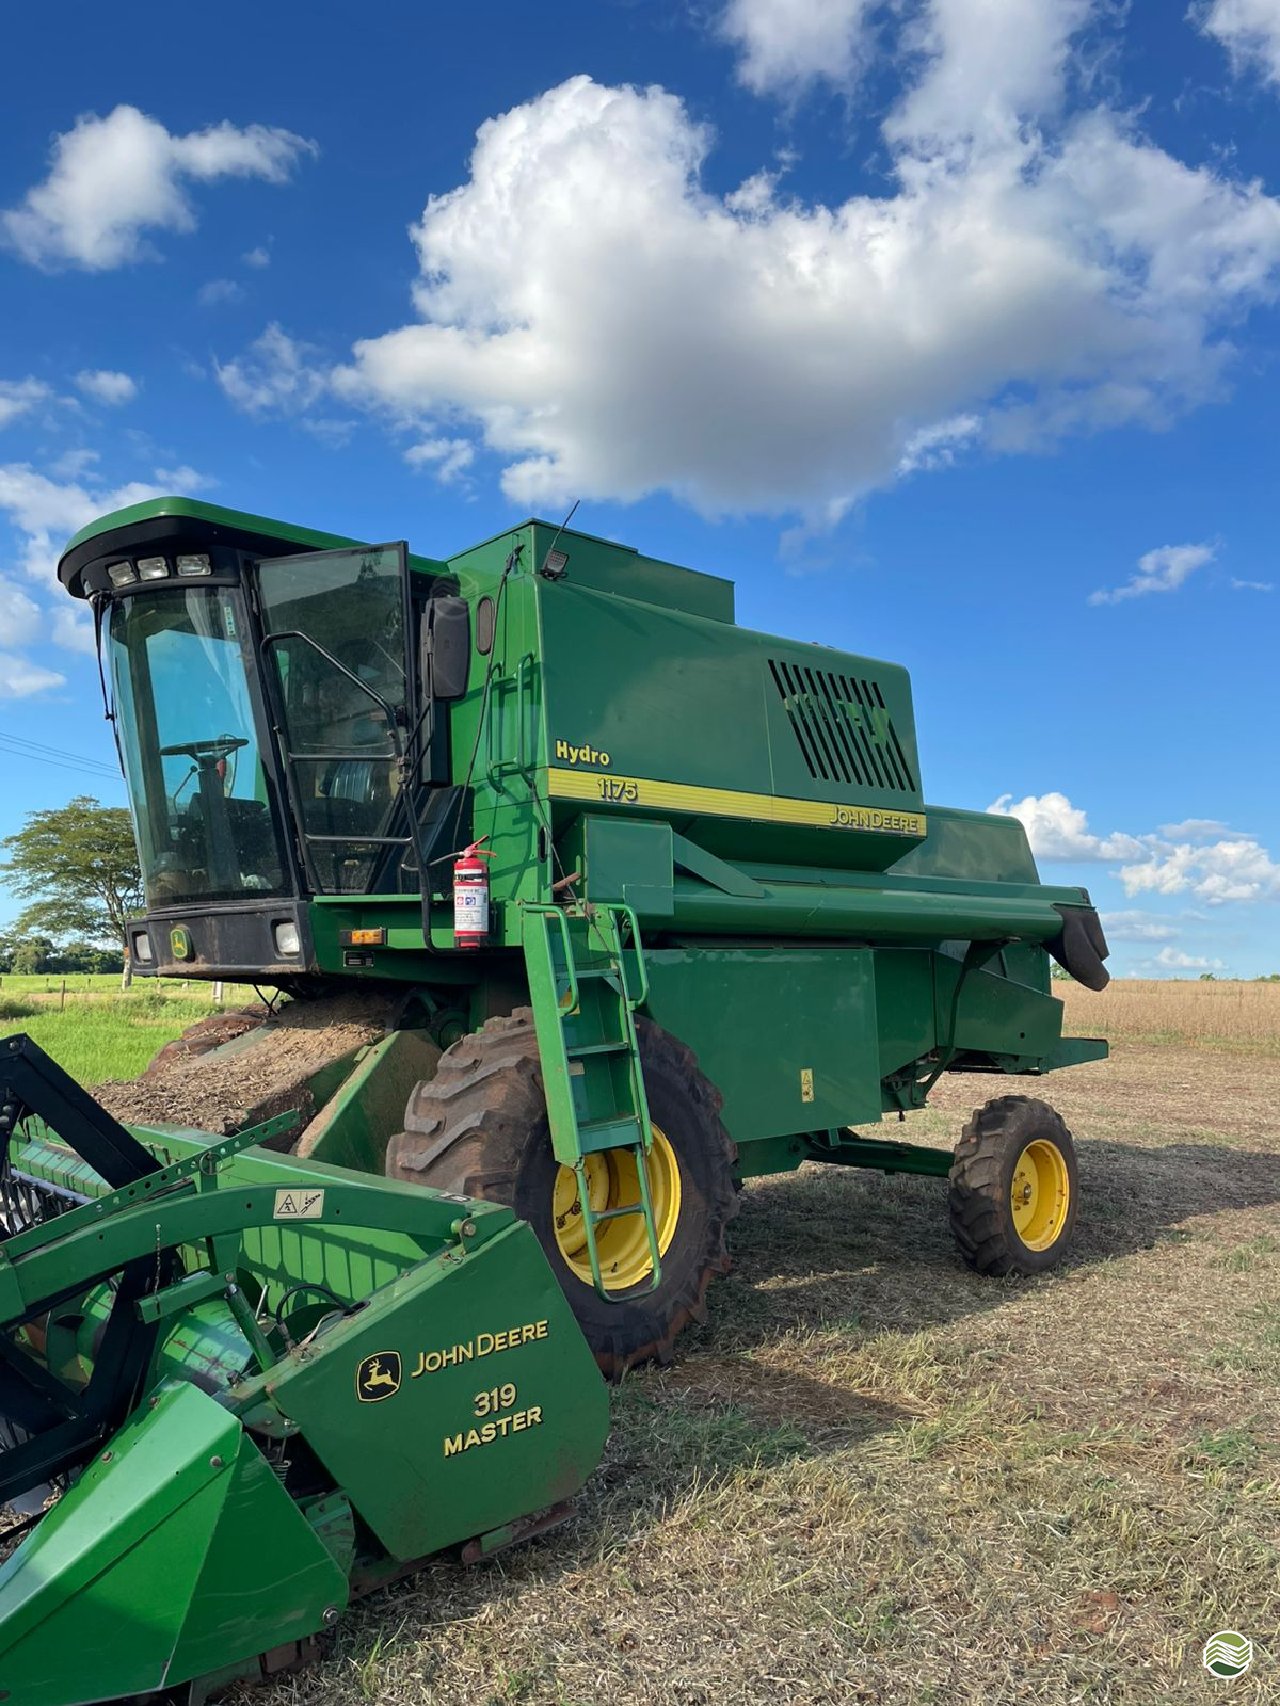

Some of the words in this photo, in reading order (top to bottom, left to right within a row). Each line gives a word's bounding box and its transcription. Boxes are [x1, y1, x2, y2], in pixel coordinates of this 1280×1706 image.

[556, 740, 610, 767] Hydro
[598, 778, 639, 801] 1175
[830, 806, 870, 826] JOHN
[872, 811, 918, 832] DEERE
[411, 1341, 474, 1378] JOHN
[477, 1320, 549, 1357] DEERE
[473, 1383, 517, 1418] 319
[444, 1406, 543, 1457] MASTER
